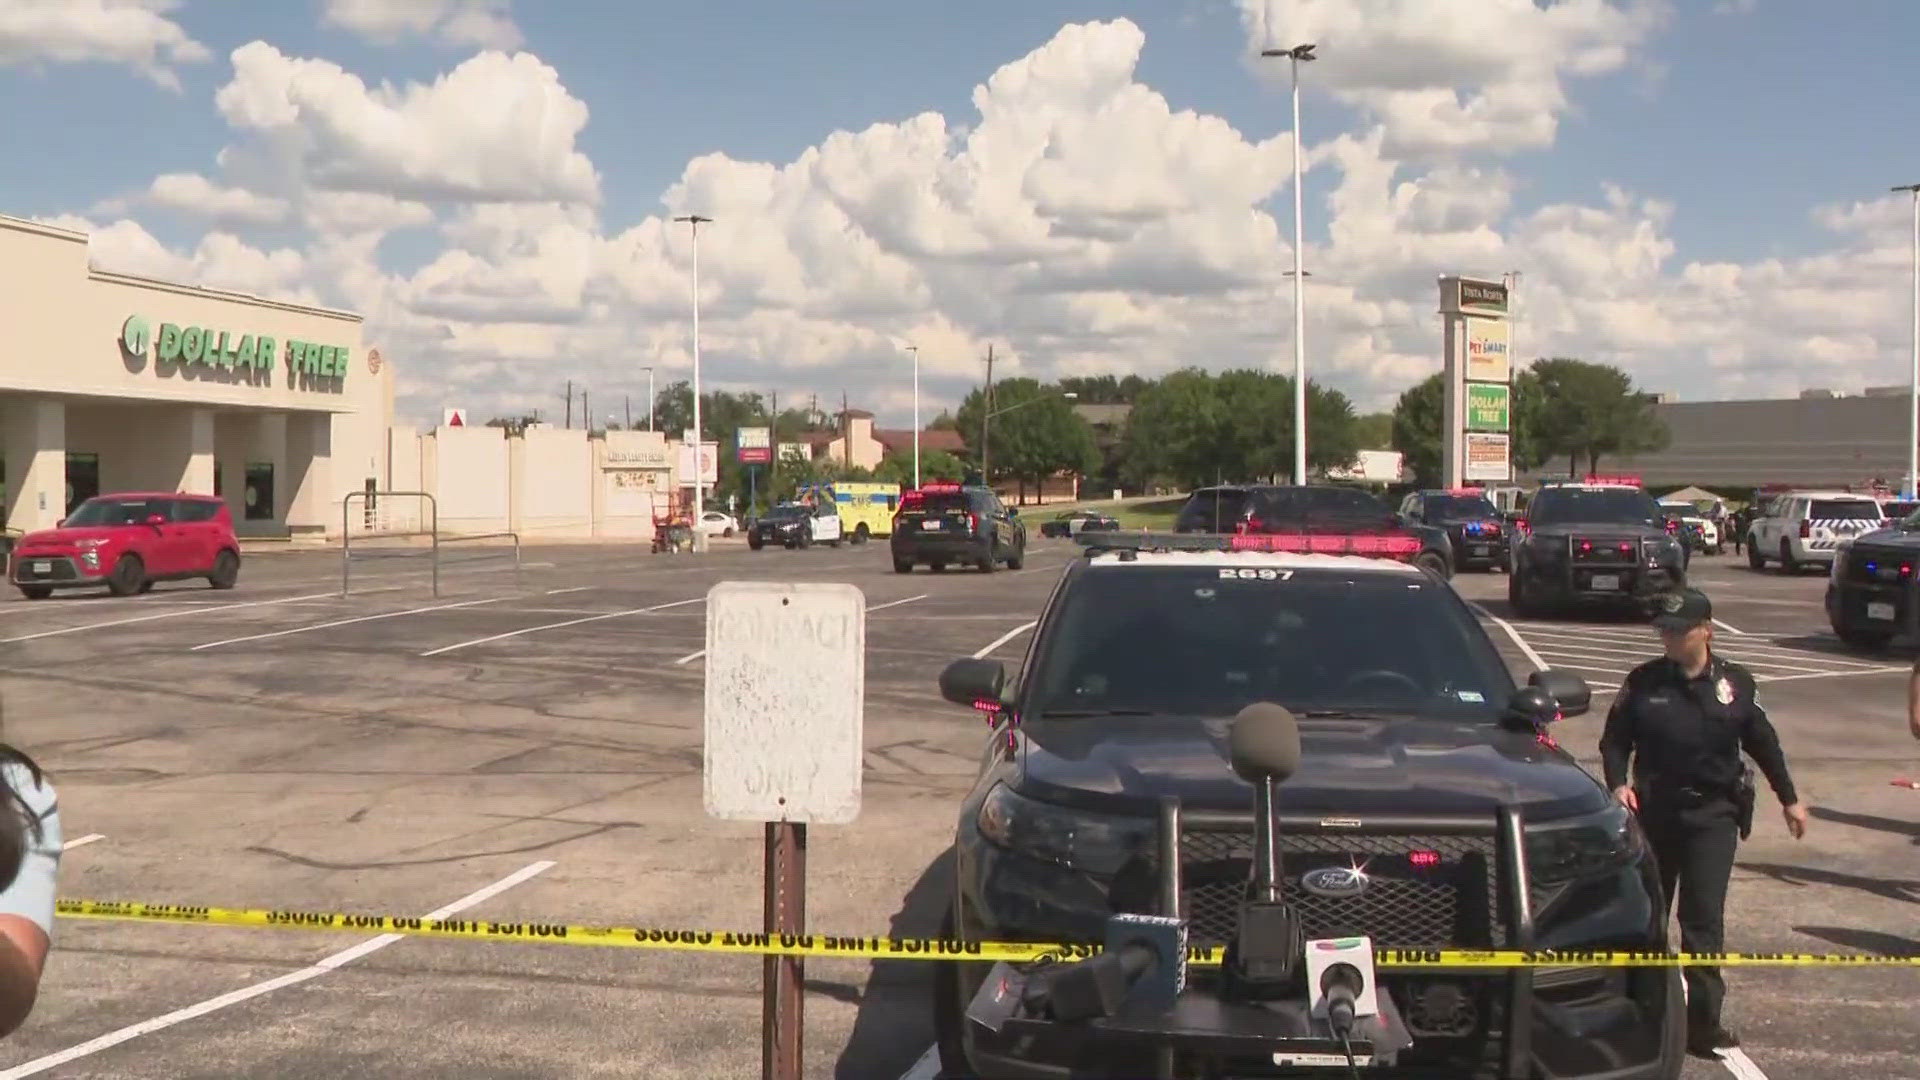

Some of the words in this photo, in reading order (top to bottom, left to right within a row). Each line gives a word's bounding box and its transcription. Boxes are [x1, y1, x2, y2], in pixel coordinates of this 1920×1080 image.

[159, 323, 276, 370] DOLLAR
[288, 339, 349, 378] TREE
[1470, 397, 1506, 410] DOLLAR
[1478, 411, 1500, 422] TREE
[1219, 569, 1294, 580] 2697
[430, 920, 478, 935] LINE
[487, 923, 568, 939] POLICE
[721, 931, 770, 947] NOT
[780, 934, 813, 949] DO
[824, 936, 879, 953] LINE
[889, 937, 981, 955] POLICE
